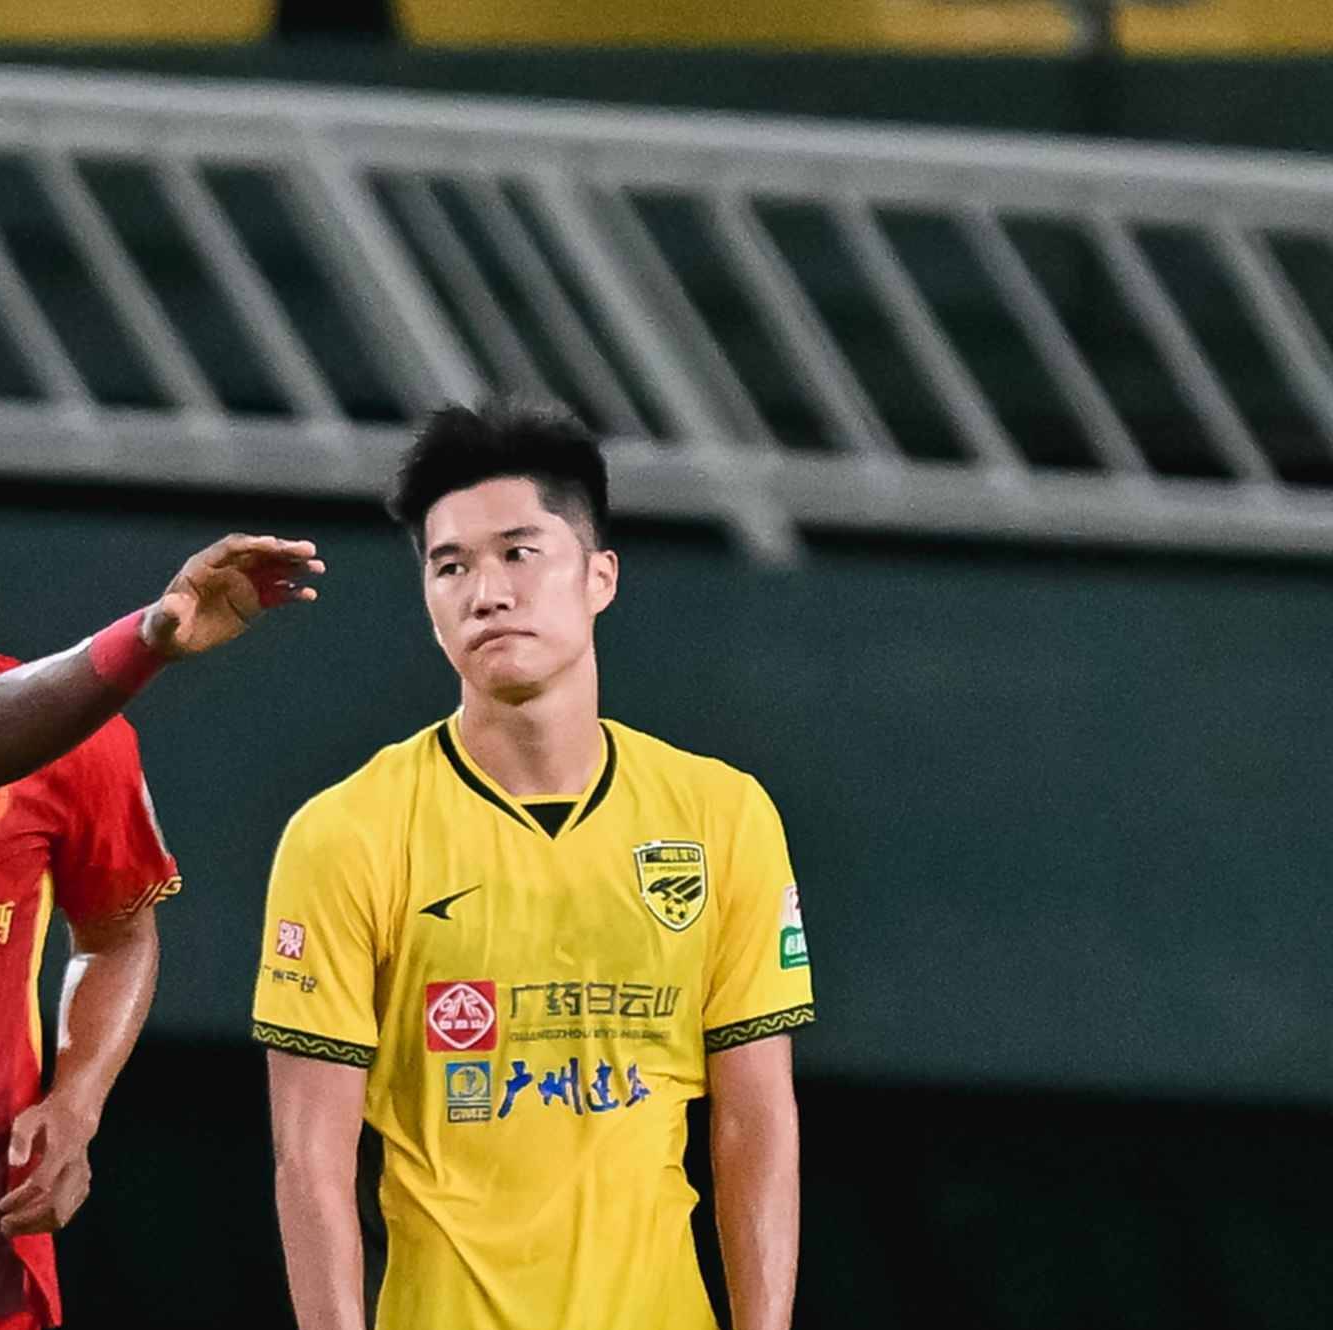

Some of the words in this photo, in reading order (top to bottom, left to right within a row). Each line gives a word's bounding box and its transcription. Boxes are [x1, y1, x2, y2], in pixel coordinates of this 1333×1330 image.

[509, 981, 682, 1019] 广药白云山
